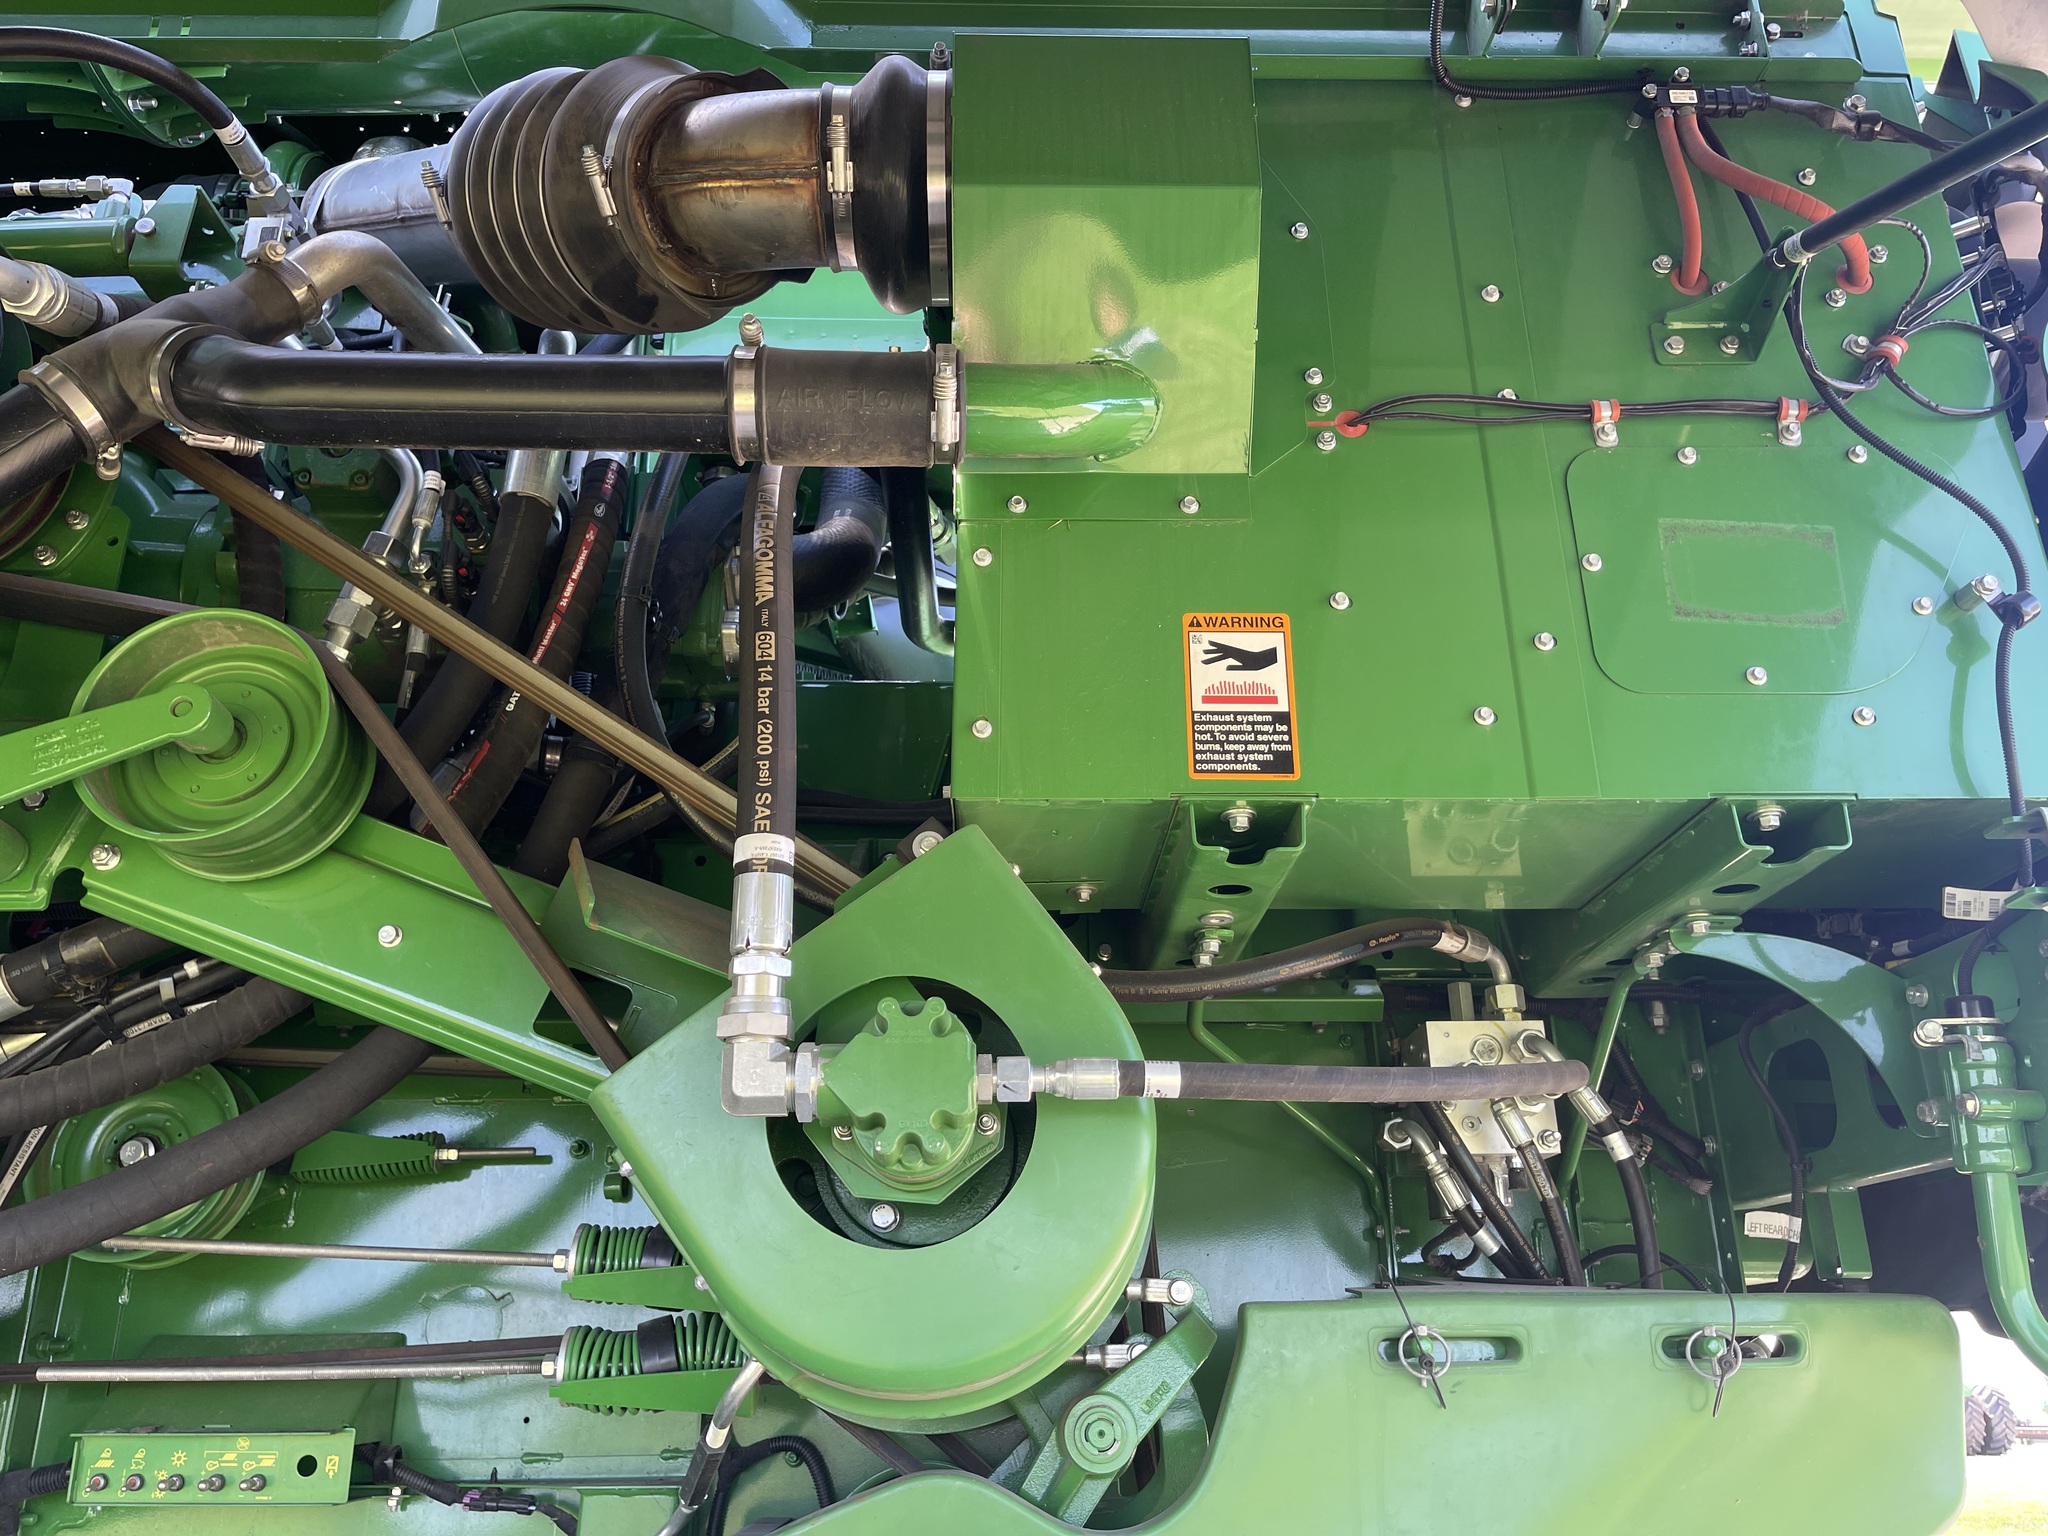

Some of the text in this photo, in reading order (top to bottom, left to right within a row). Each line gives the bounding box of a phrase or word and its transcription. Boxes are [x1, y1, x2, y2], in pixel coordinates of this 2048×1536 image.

[777, 387, 823, 408] AIR
[754, 502, 775, 606] ALFAGOMMA
[559, 596, 568, 607] 24
[761, 608, 769, 628] ITALY
[1203, 616, 1284, 628] WARNING
[1194, 713, 1272, 724] Exhaust system
[753, 632, 773, 832] 604 14 bar (200 psi) SAE
[1194, 723, 1288, 734] components may be
[1195, 732, 1290, 742] hot. To avoid severe
[1195, 742, 1292, 753] burns, keep away from
[1195, 752, 1274, 764] exhaust system
[1196, 762, 1261, 772] components.
[1114, 985, 1129, 995] Type
[1148, 986, 1169, 996] Flame
[1169, 984, 1200, 995] Resistant
[1201, 981, 1221, 991] MSHA
[8, 1139, 33, 1177] RESISTANT
[1747, 1222, 1763, 1233] LEFT
[1764, 1224, 1783, 1236] REAR
